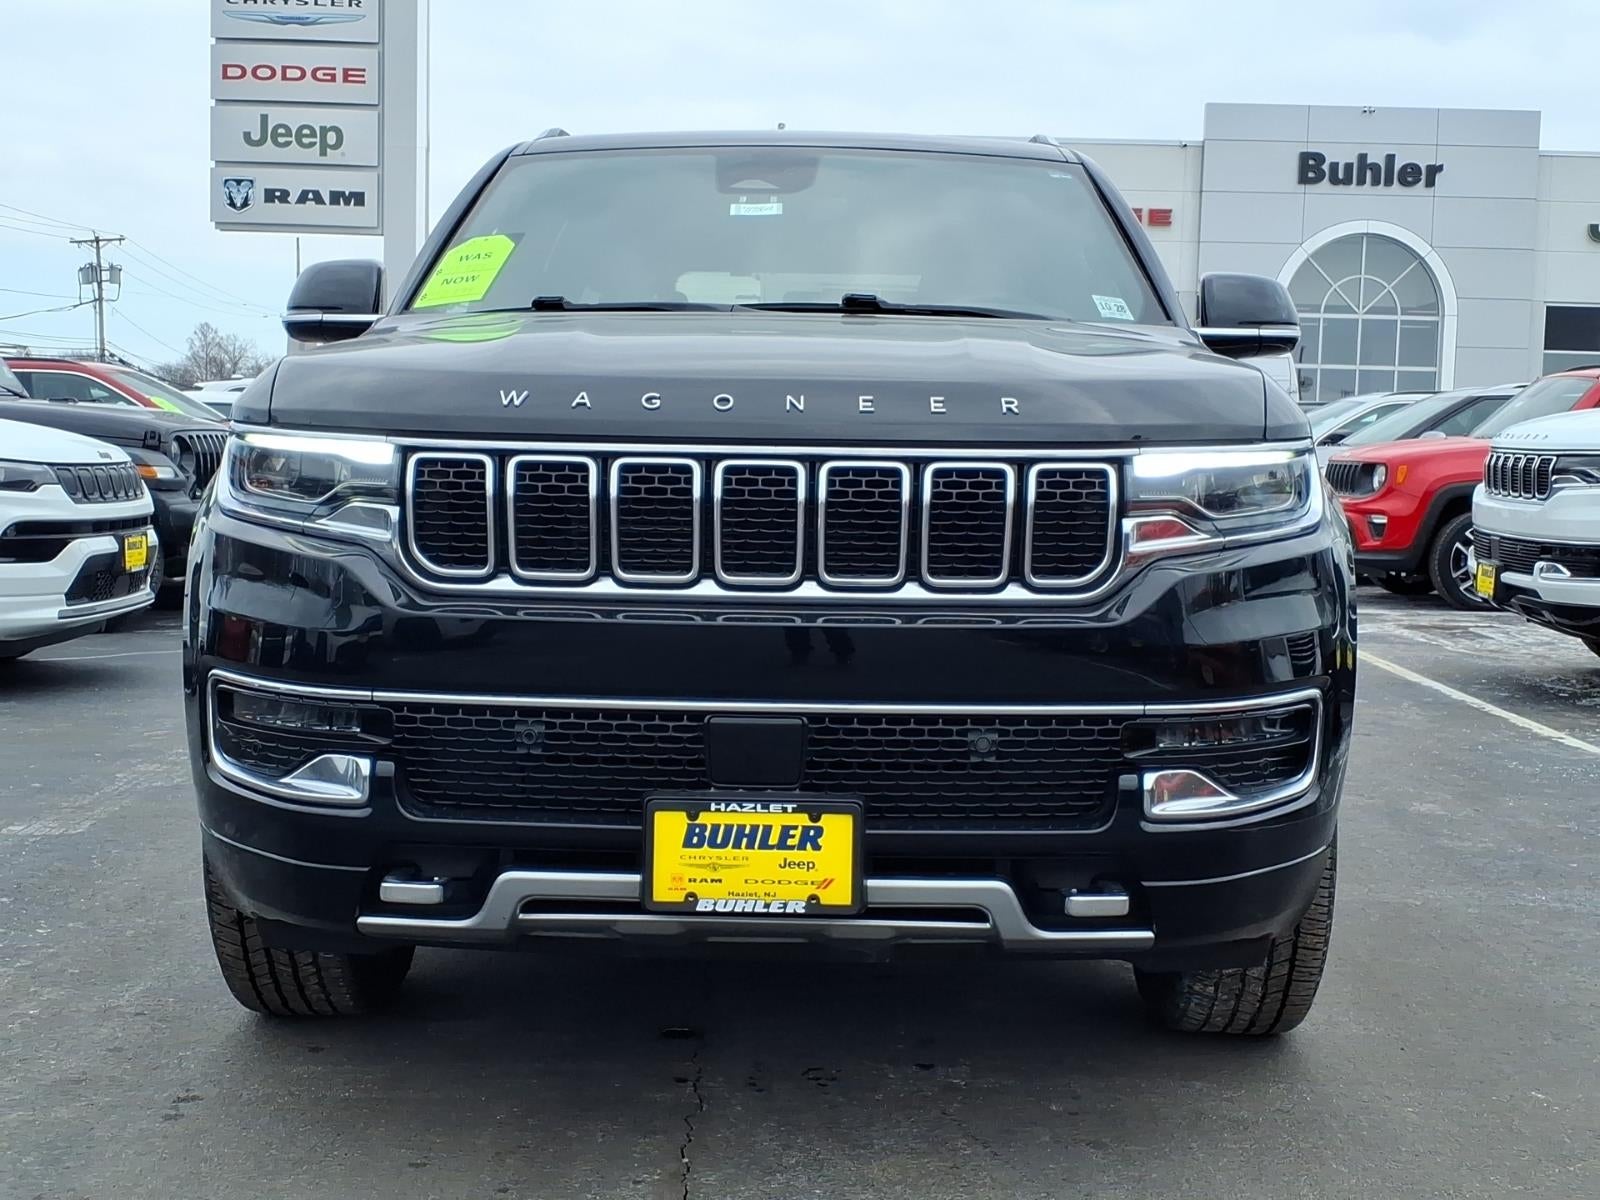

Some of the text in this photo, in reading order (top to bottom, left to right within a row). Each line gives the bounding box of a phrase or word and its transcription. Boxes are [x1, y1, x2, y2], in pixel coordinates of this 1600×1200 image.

[222, 64, 366, 84] DODGE
[243, 114, 344, 157] Jeep
[1298, 151, 1444, 188] Buhler
[264, 187, 366, 207] RAM
[460, 252, 494, 262] WAS
[440, 275, 481, 286] NOW
[499, 389, 1020, 415] WAGONEER
[710, 802, 798, 813] HAZLET
[682, 823, 824, 851] BUHLER
[778, 857, 817, 872] Jeep
[744, 878, 822, 886] DODGE
[696, 899, 806, 913] BUHLER
